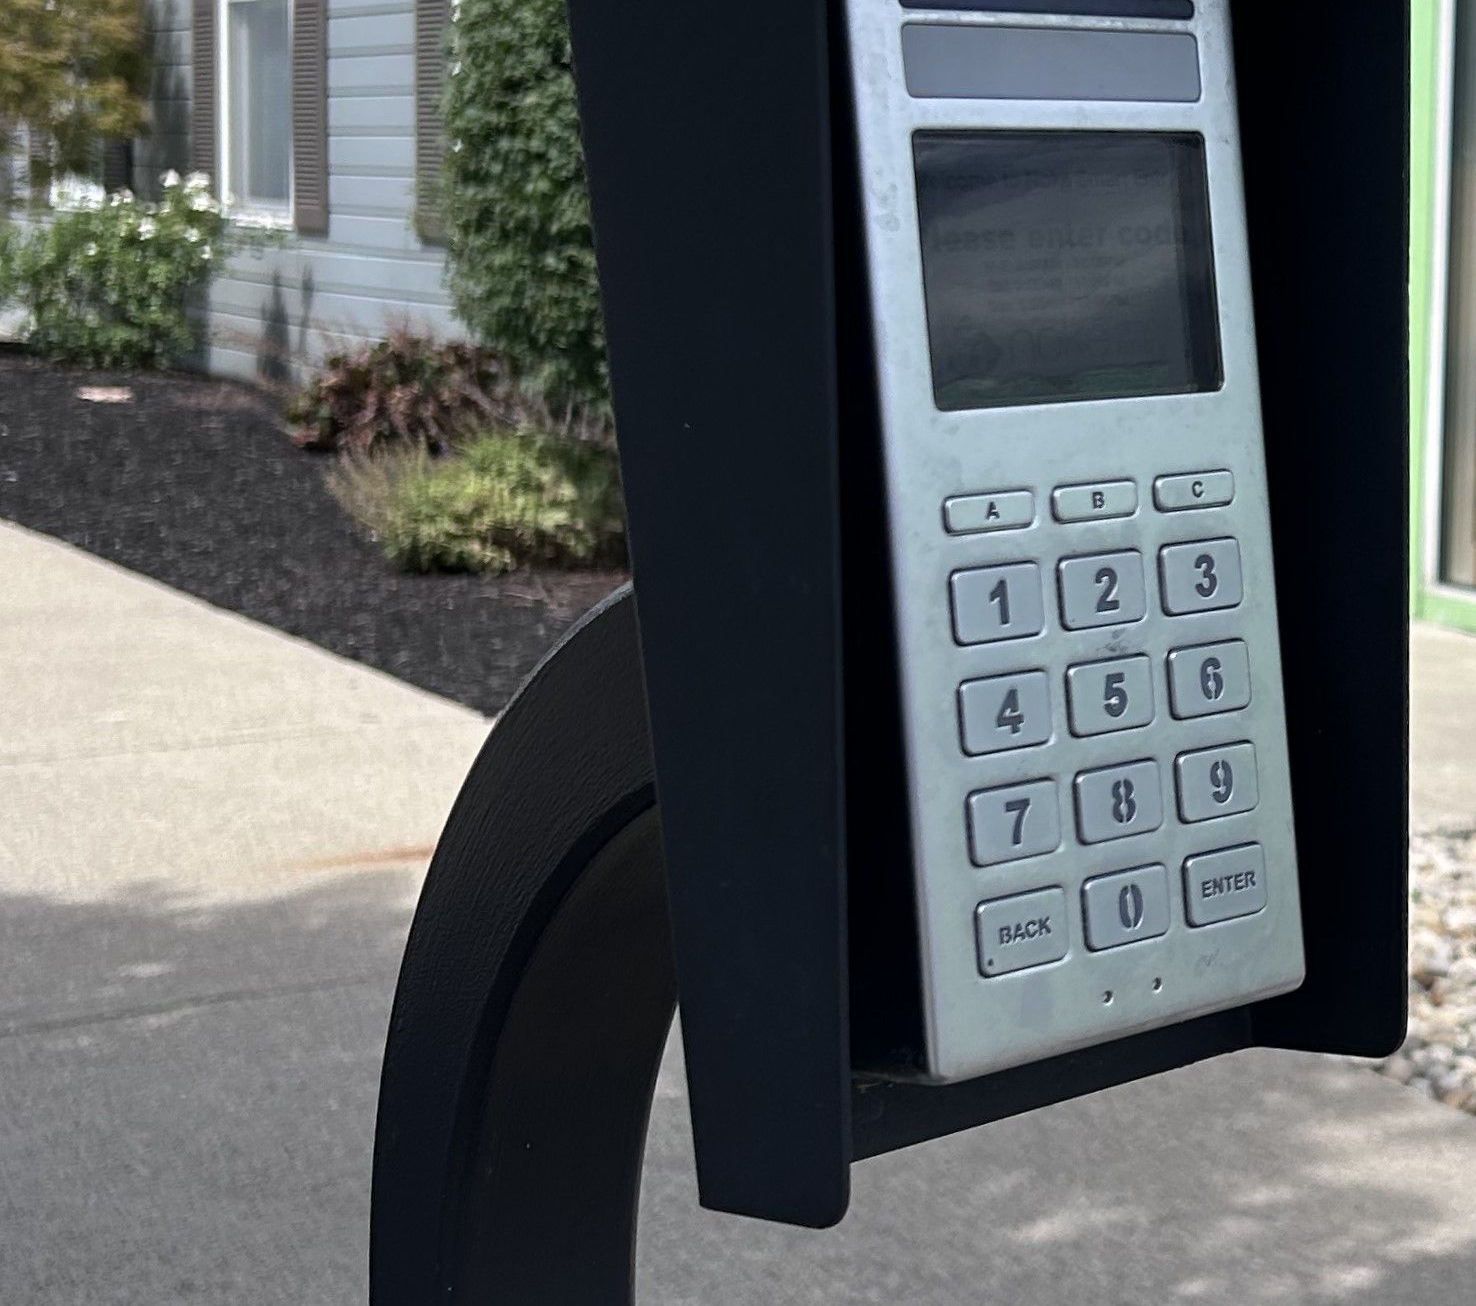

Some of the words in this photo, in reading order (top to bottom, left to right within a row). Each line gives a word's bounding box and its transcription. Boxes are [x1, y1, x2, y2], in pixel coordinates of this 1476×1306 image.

[985, 501, 1000, 521] A
[1092, 491, 1105, 510] B
[1192, 480, 1205, 499] C
[1095, 567, 1120, 613] 2
[1195, 553, 1218, 598] 3
[988, 578, 1011, 625] 1
[1104, 672, 1128, 718] 5
[1201, 656, 1224, 701] 6
[996, 688, 1024, 735] 4
[1112, 778, 1136, 824] 8
[1210, 759, 1233, 803] 9
[1005, 797, 1031, 846] 7
[1119, 883, 1143, 930] 0
[1201, 870, 1257, 900] ENTER
[998, 916, 1052, 946] BACK
